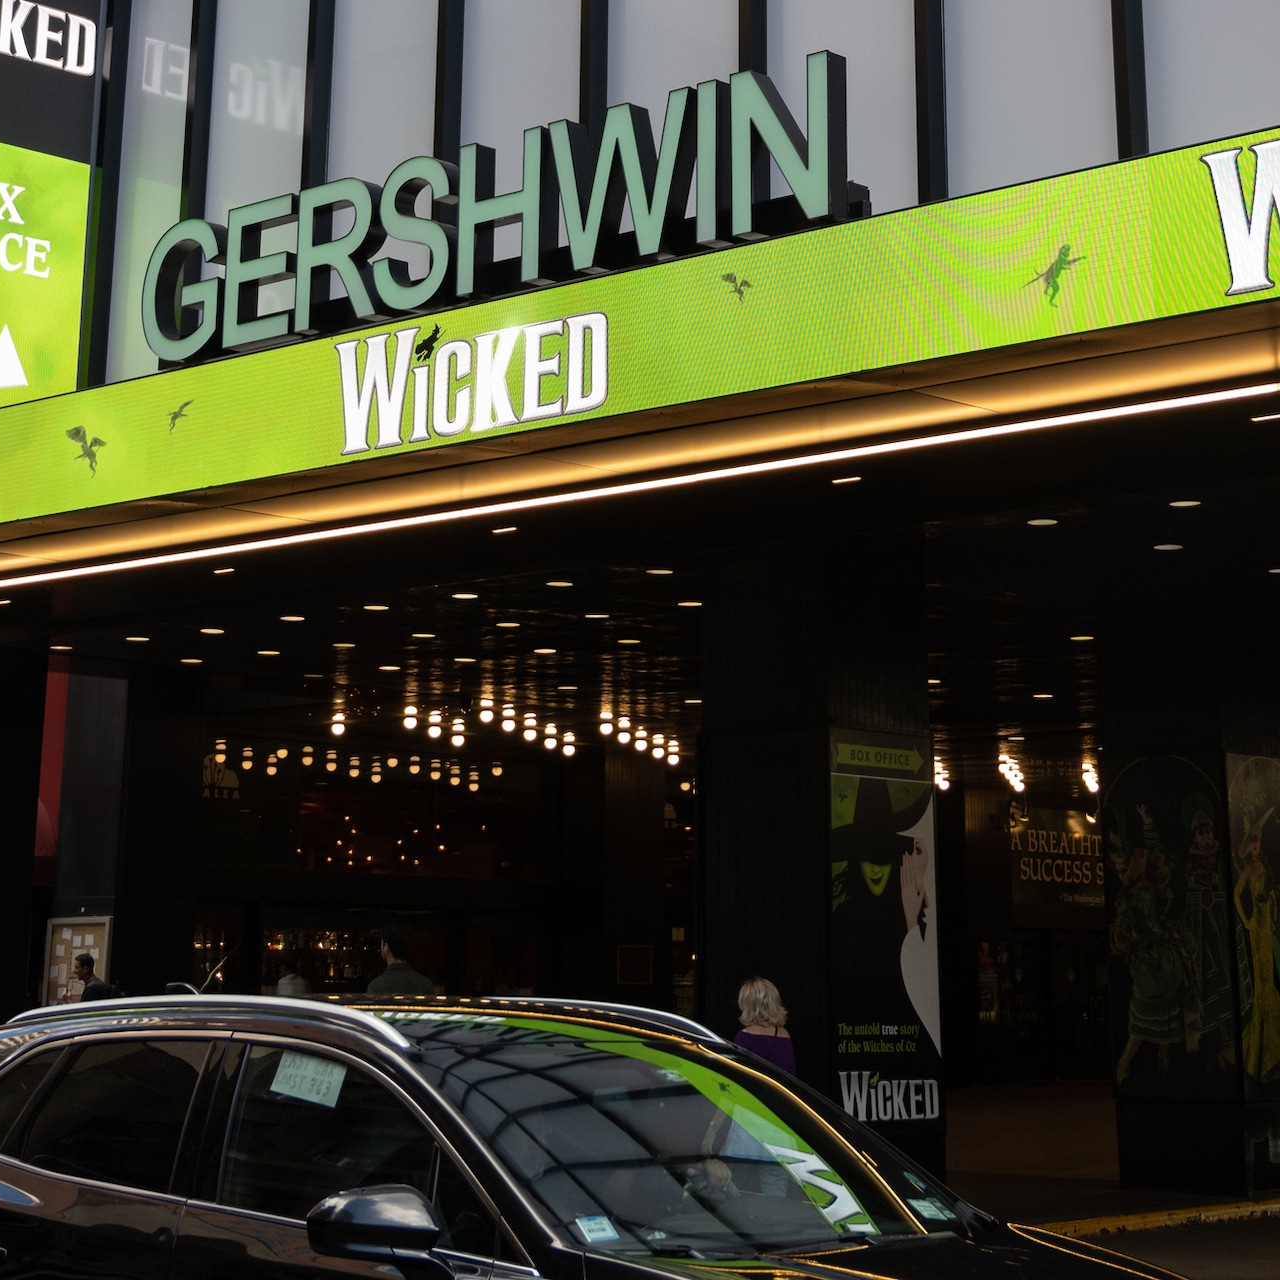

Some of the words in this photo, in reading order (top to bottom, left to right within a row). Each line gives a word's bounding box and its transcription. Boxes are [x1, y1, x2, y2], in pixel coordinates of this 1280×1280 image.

[141, 49, 838, 362] GERSHWIN
[850, 749, 870, 762] BOX
[874, 751, 910, 766] OFFICE
[1027, 829, 1103, 856] BREATHT
[1020, 857, 1092, 885] SUCCESS
[837, 1022, 853, 1036] The
[855, 1022, 881, 1036] untold
[881, 1024, 898, 1036] true
[900, 1024, 920, 1039] story
[838, 1040, 847, 1053] of
[848, 1040, 861, 1053] the
[862, 1039, 895, 1053] Witches
[896, 1039, 905, 1052] of
[905, 1042, 917, 1053] Oz
